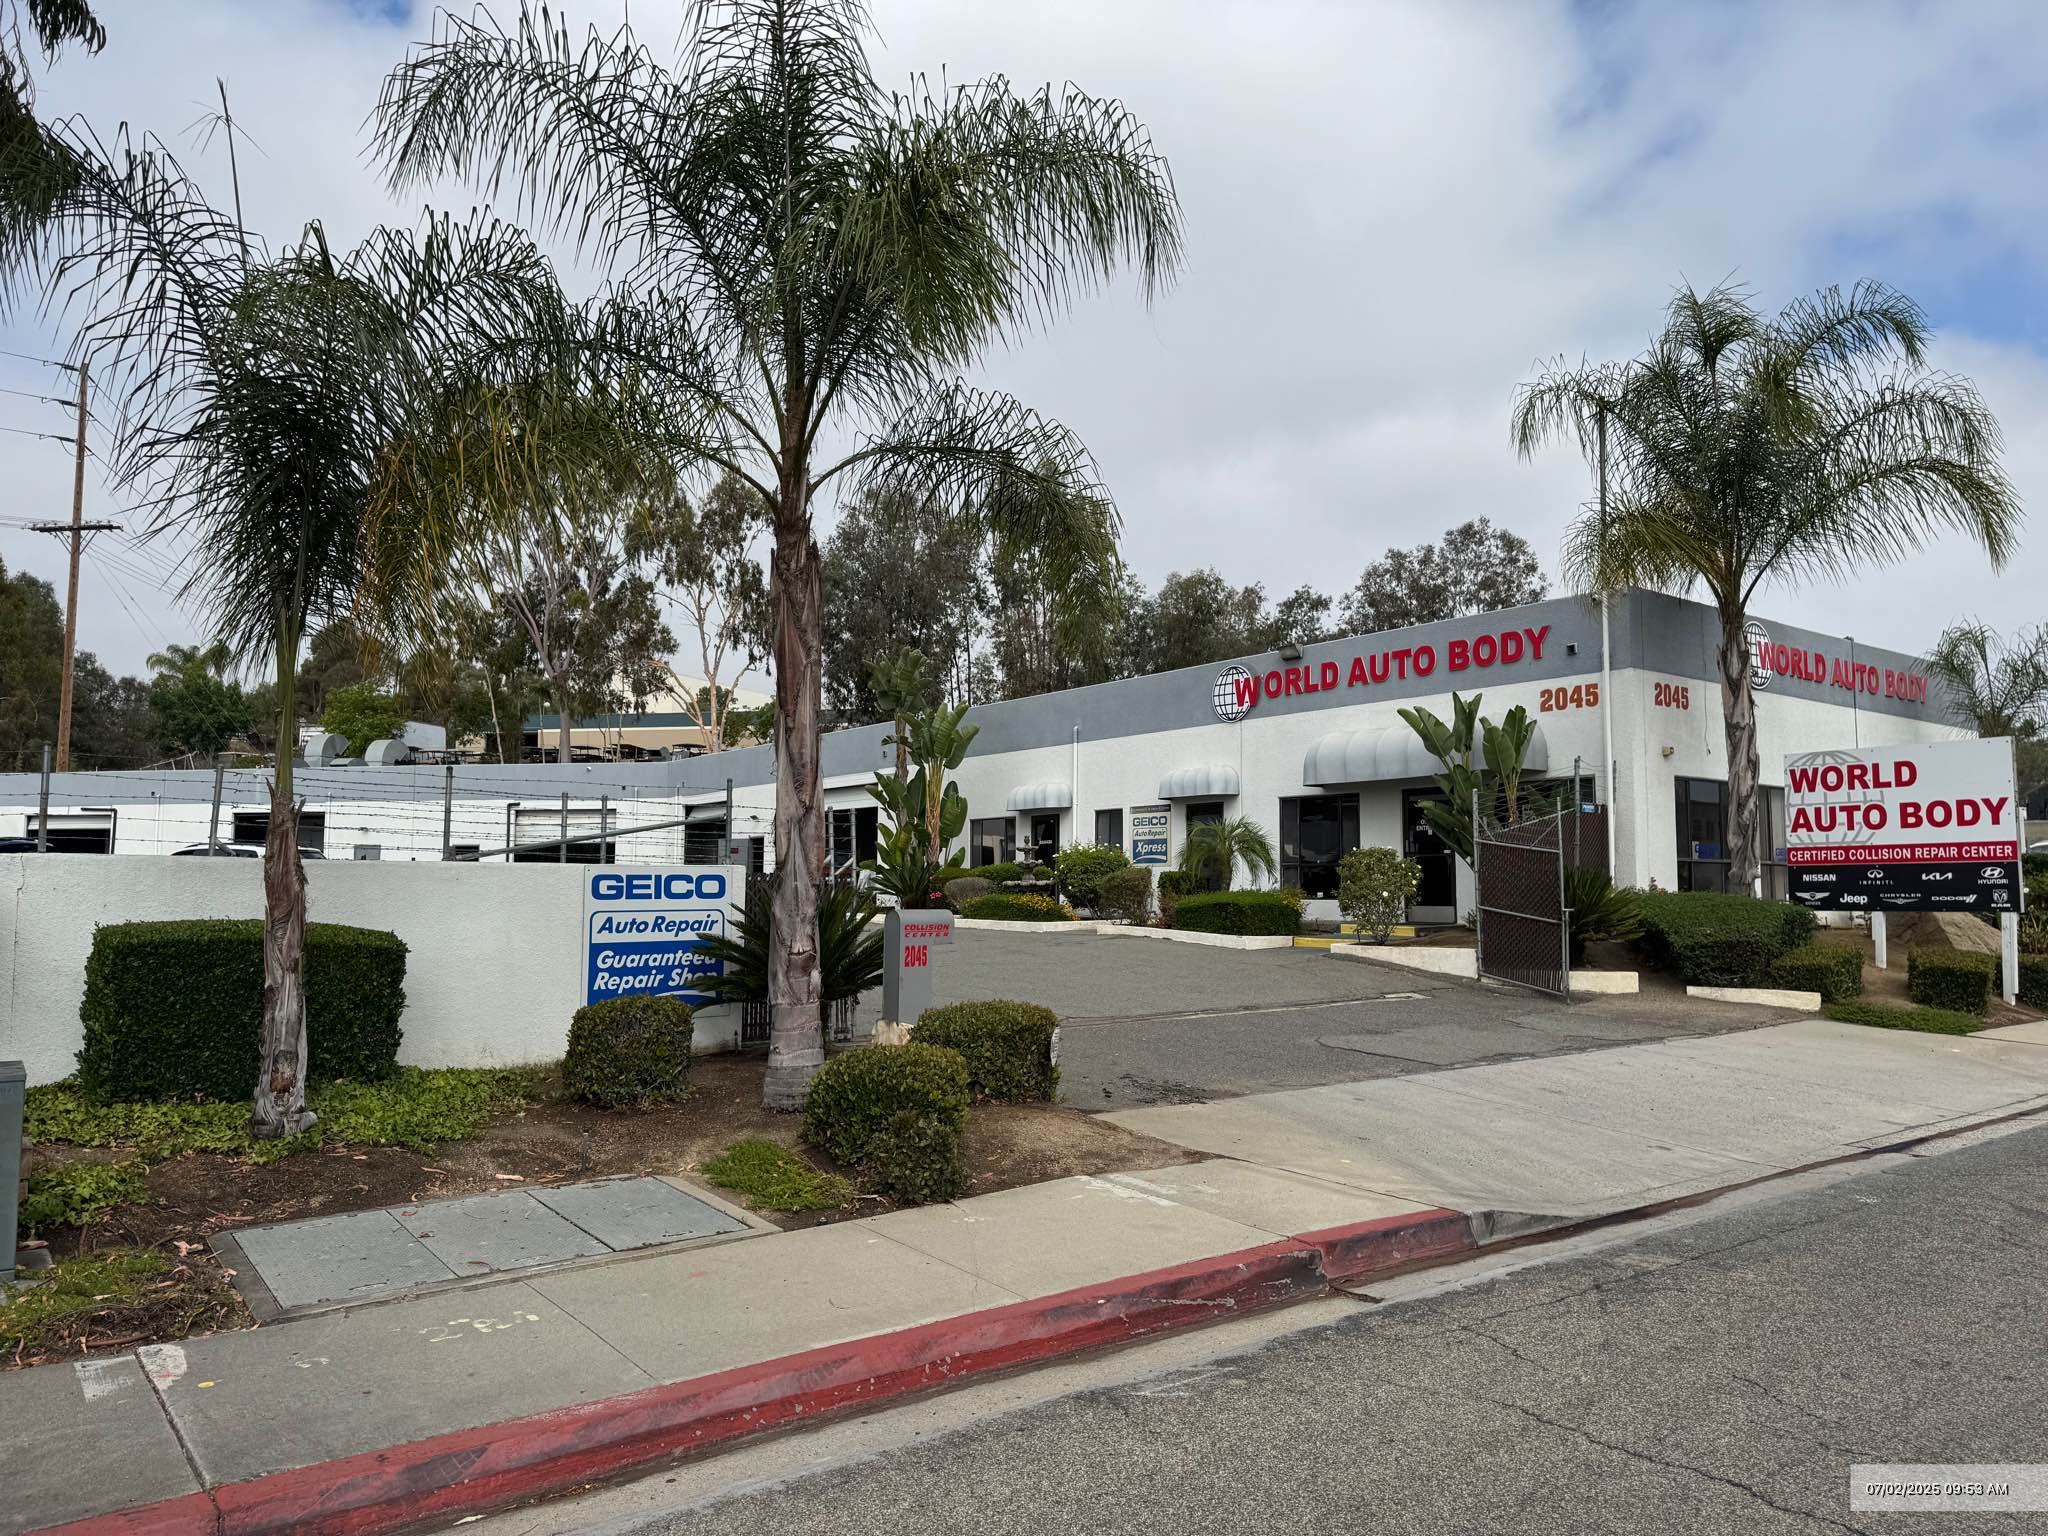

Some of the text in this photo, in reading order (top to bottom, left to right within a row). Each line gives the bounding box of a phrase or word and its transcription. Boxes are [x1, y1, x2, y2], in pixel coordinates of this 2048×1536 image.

[1234, 624, 1552, 708] WORLD AUTO BODY
[1757, 640, 1928, 704] WORLD AUTO BODY
[1539, 683, 1599, 712] 2045
[1654, 682, 1689, 710] 2045
[1789, 760, 1918, 794] WORLD
[1133, 816, 1167, 826] GEICO
[1790, 797, 2010, 833] AUTO BODY
[1148, 829, 1165, 838] Repair
[1136, 842, 1166, 855] Xpress
[1790, 850, 1845, 862] CERTIFIED
[1849, 847, 1911, 860] COLLISION
[1915, 847, 1958, 858] REPAIR
[1962, 845, 2013, 857] CENTER
[592, 874, 726, 900] GEICO
[1802, 873, 1836, 882] NISSAN
[1840, 892, 1868, 905] Jeep
[597, 914, 718, 937] Auto Repair
[904, 945, 928, 967] 2045
[593, 970, 664, 993] Repair
